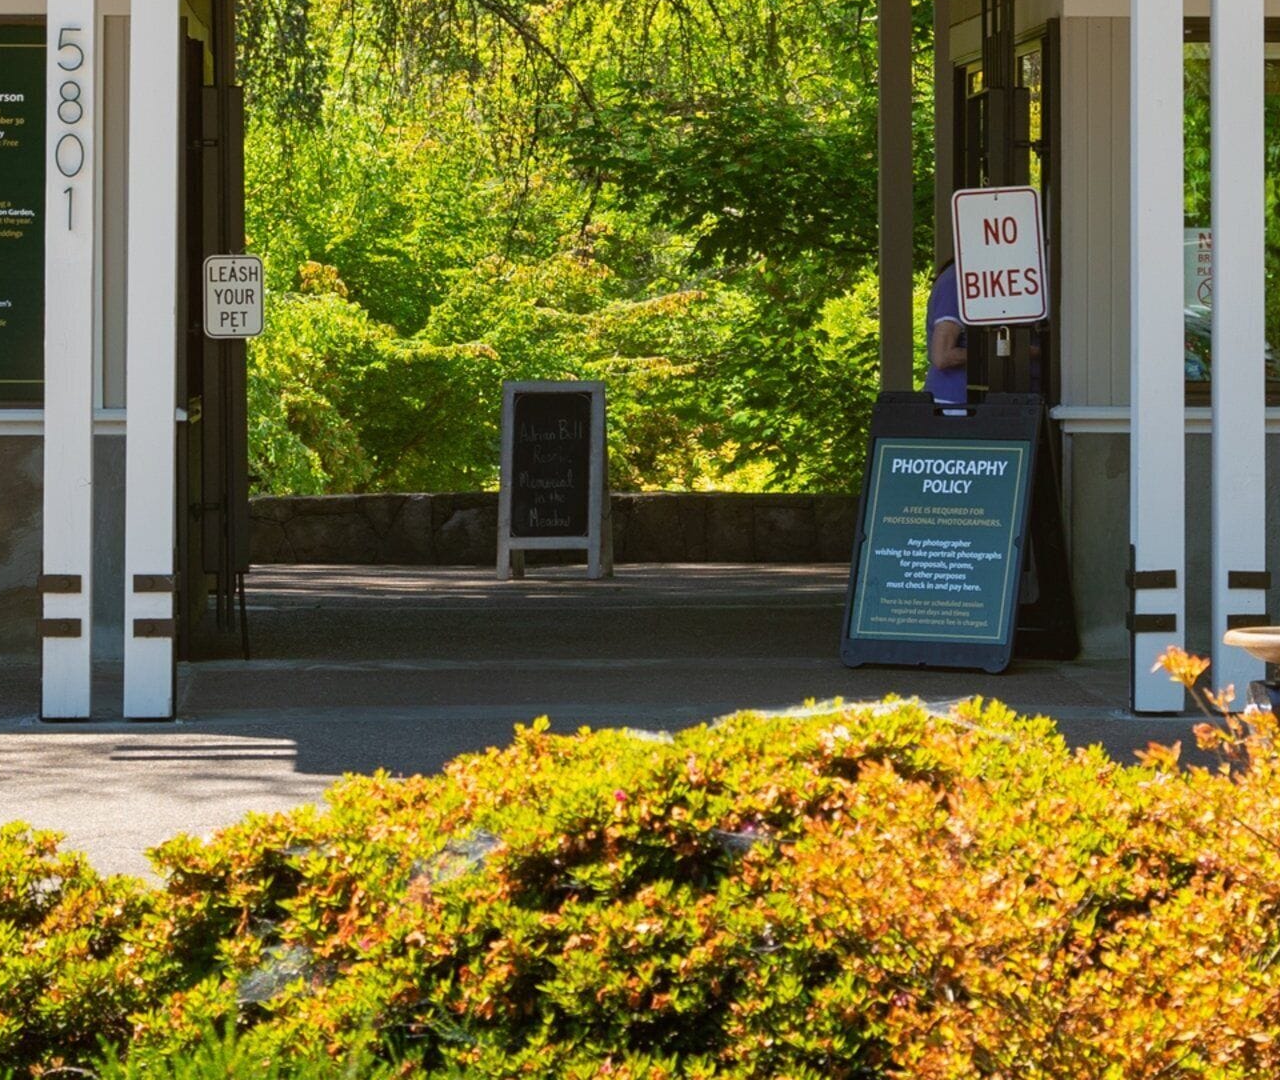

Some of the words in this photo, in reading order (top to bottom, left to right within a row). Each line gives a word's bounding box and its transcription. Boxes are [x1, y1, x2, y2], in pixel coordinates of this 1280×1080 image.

[56, 27, 84, 231] 5801
[984, 216, 1017, 245] NO
[209, 267, 258, 282] LEASH
[965, 268, 1038, 299] BIKES
[214, 289, 254, 304] YOUR
[220, 312, 247, 327] PET
[892, 459, 1008, 476] PHOTOGRAPHY
[923, 480, 971, 494] POLICY
[932, 507, 968, 515] REQUIRED
[883, 517, 935, 525] PROFESSIONAL
[908, 539, 921, 547] Any
[923, 539, 971, 548] photographer
[875, 548, 901, 558] wishing
[957, 551, 1002, 560] photographs
